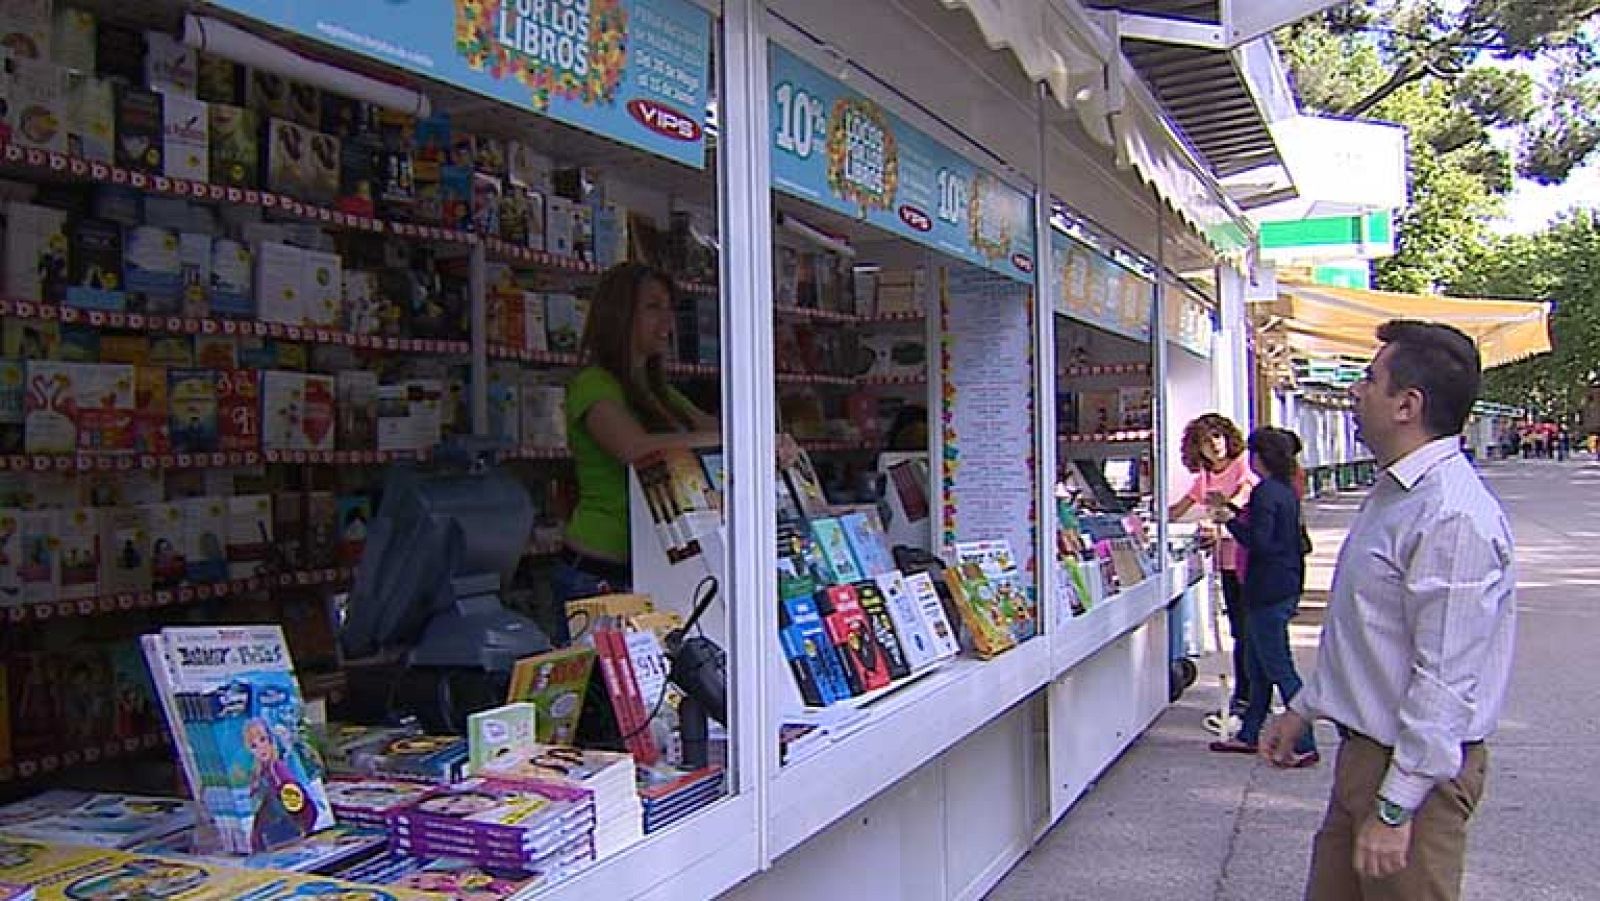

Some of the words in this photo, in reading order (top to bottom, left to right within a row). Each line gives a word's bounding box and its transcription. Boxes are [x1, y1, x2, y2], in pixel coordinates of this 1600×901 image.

[552, 1, 590, 41] LOS
[500, 9, 589, 76] LIBROS
[638, 103, 693, 138] VIPS
